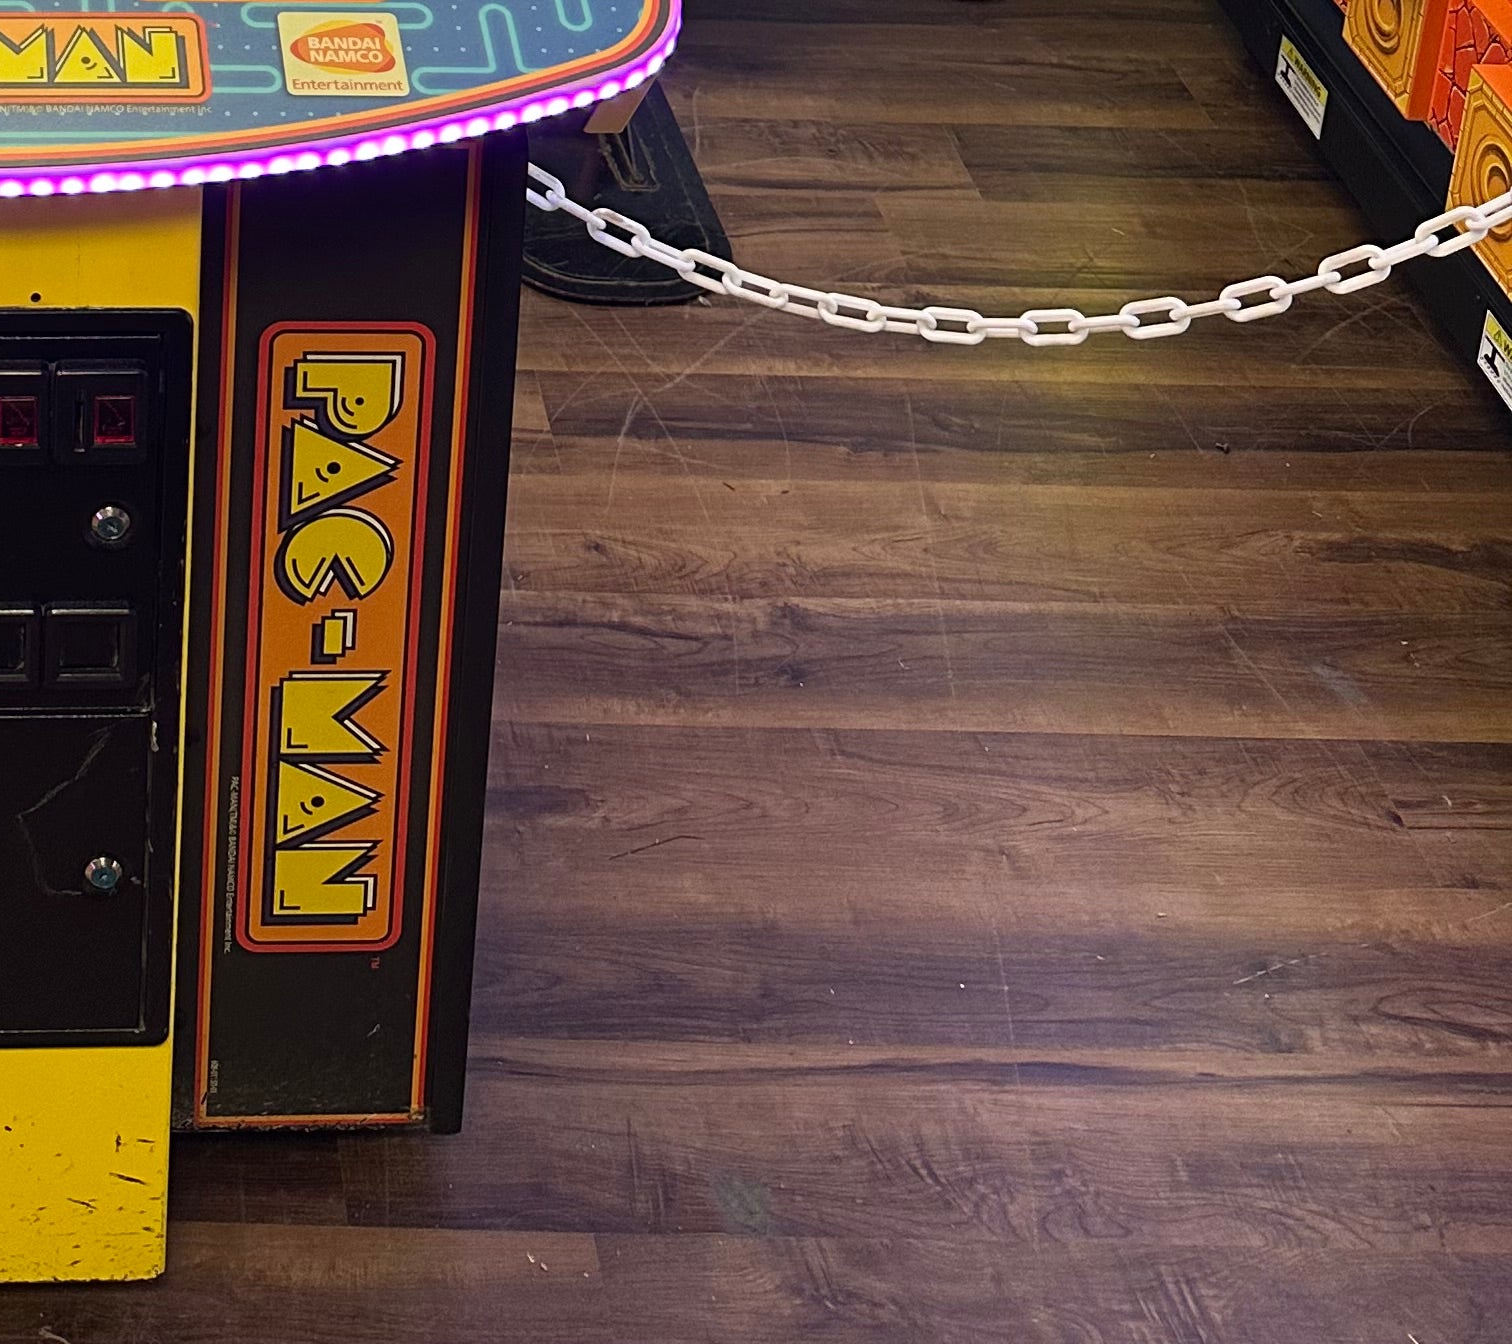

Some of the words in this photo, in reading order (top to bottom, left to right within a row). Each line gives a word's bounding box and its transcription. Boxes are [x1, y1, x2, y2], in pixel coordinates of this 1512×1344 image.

[307, 37, 381, 50] BANDAI
[310, 50, 383, 63] NAMCO
[292, 78, 404, 91] Entertainment
[46, 105, 84, 113] BANDAI
[87, 105, 124, 113] NAMCO
[262, 351, 405, 925] PAC-MAN
